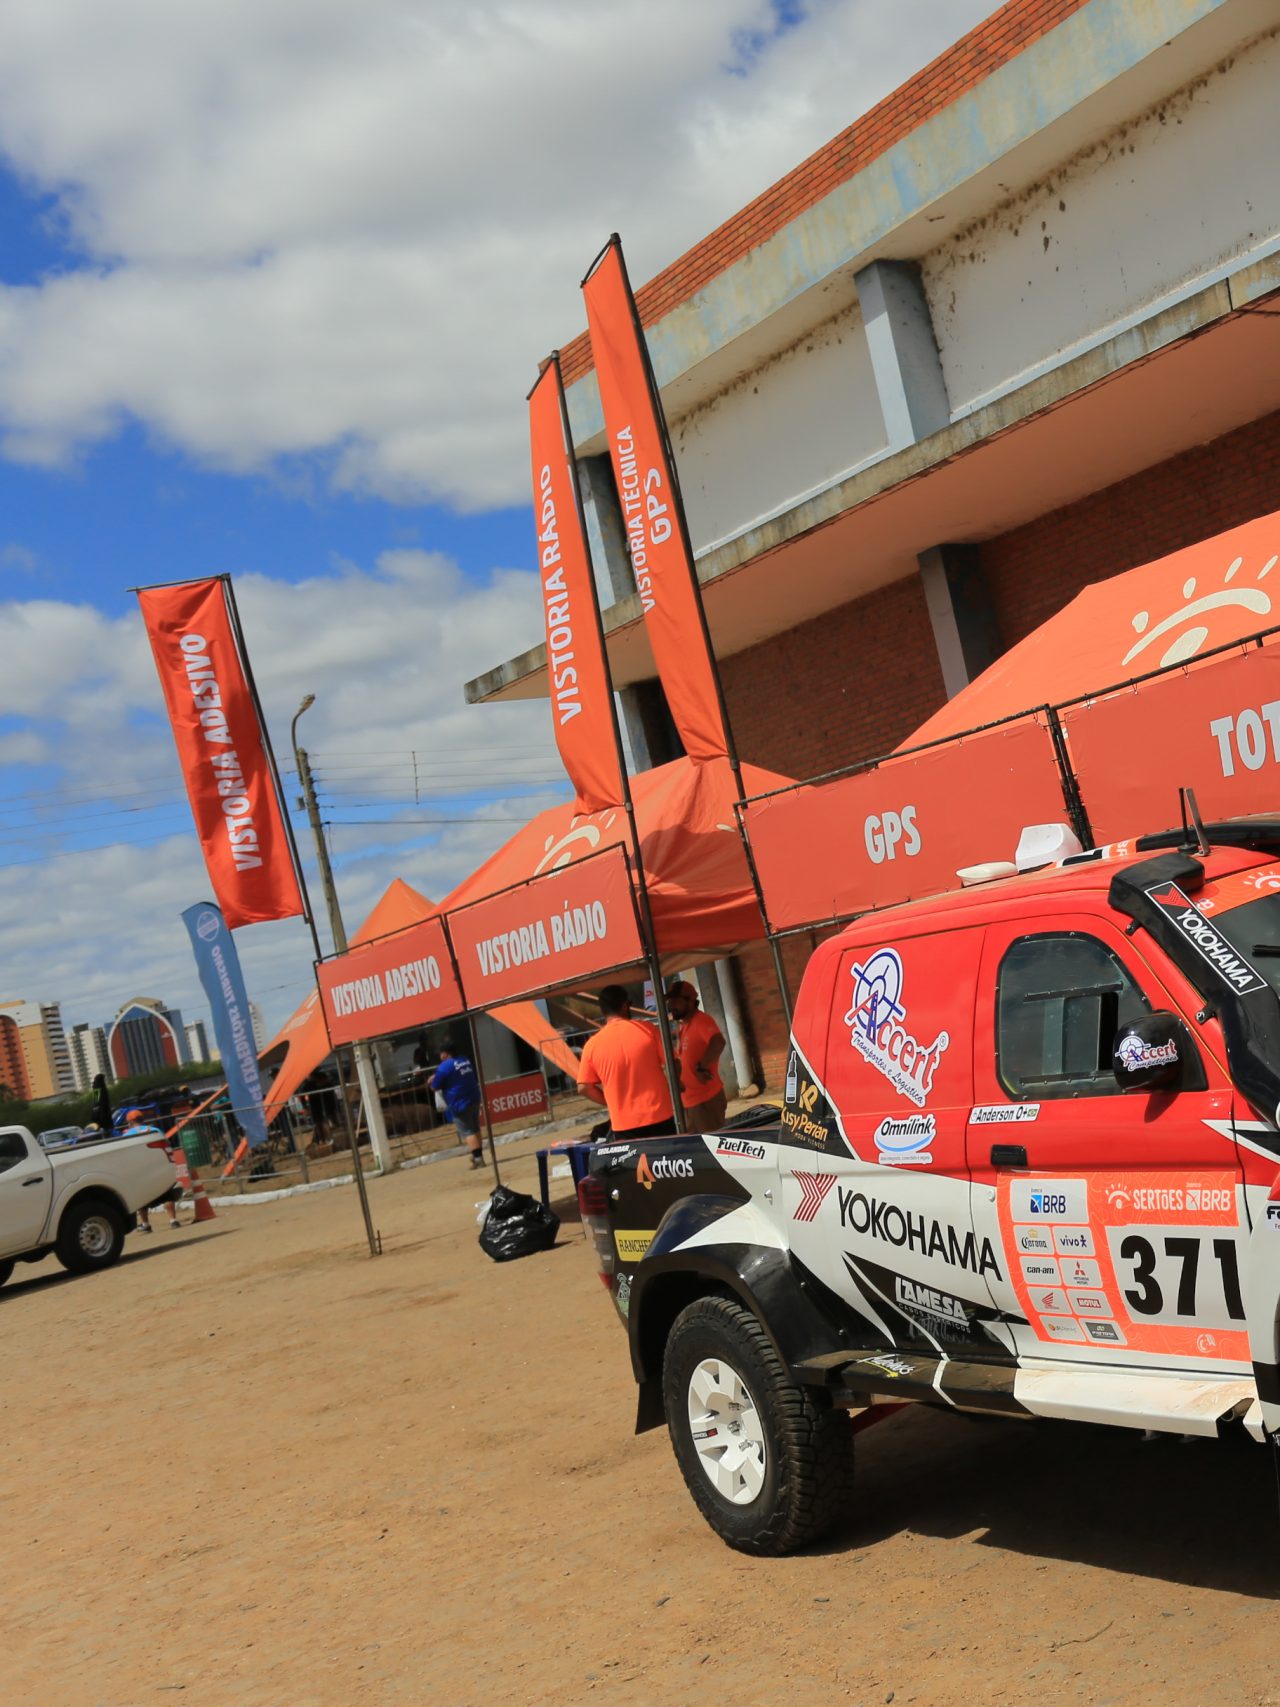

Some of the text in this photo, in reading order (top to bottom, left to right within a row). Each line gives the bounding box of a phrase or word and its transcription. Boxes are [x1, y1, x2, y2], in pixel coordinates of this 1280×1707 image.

[616, 425, 656, 614] VISTORIA TÉCNICA
[643, 467, 673, 546] GPS
[539, 464, 582, 726] VISTORIA RÁDIO
[179, 634, 263, 872] VISTORIA ADESIVO
[864, 805, 921, 864] GPS
[476, 900, 607, 977] VISTORIA RÁDIO
[1177, 907, 1254, 989] YOKOHAMA
[331, 955, 441, 1017] VISTORIA ADESIVO
[492, 1089, 542, 1112] SERTÕES
[881, 1117, 933, 1136] Omnilink
[974, 1107, 1014, 1122] Anderson
[652, 1156, 695, 1179] atvos
[717, 1137, 766, 1160] FuelTech
[1043, 1195, 1066, 1213] BRB
[1133, 1188, 1183, 1211] SERTÕES
[1202, 1190, 1231, 1211] BRB
[838, 1185, 1004, 1282] YOKOHAMA
[1060, 1235, 1079, 1246] vivo
[1120, 1234, 1247, 1321] 371
